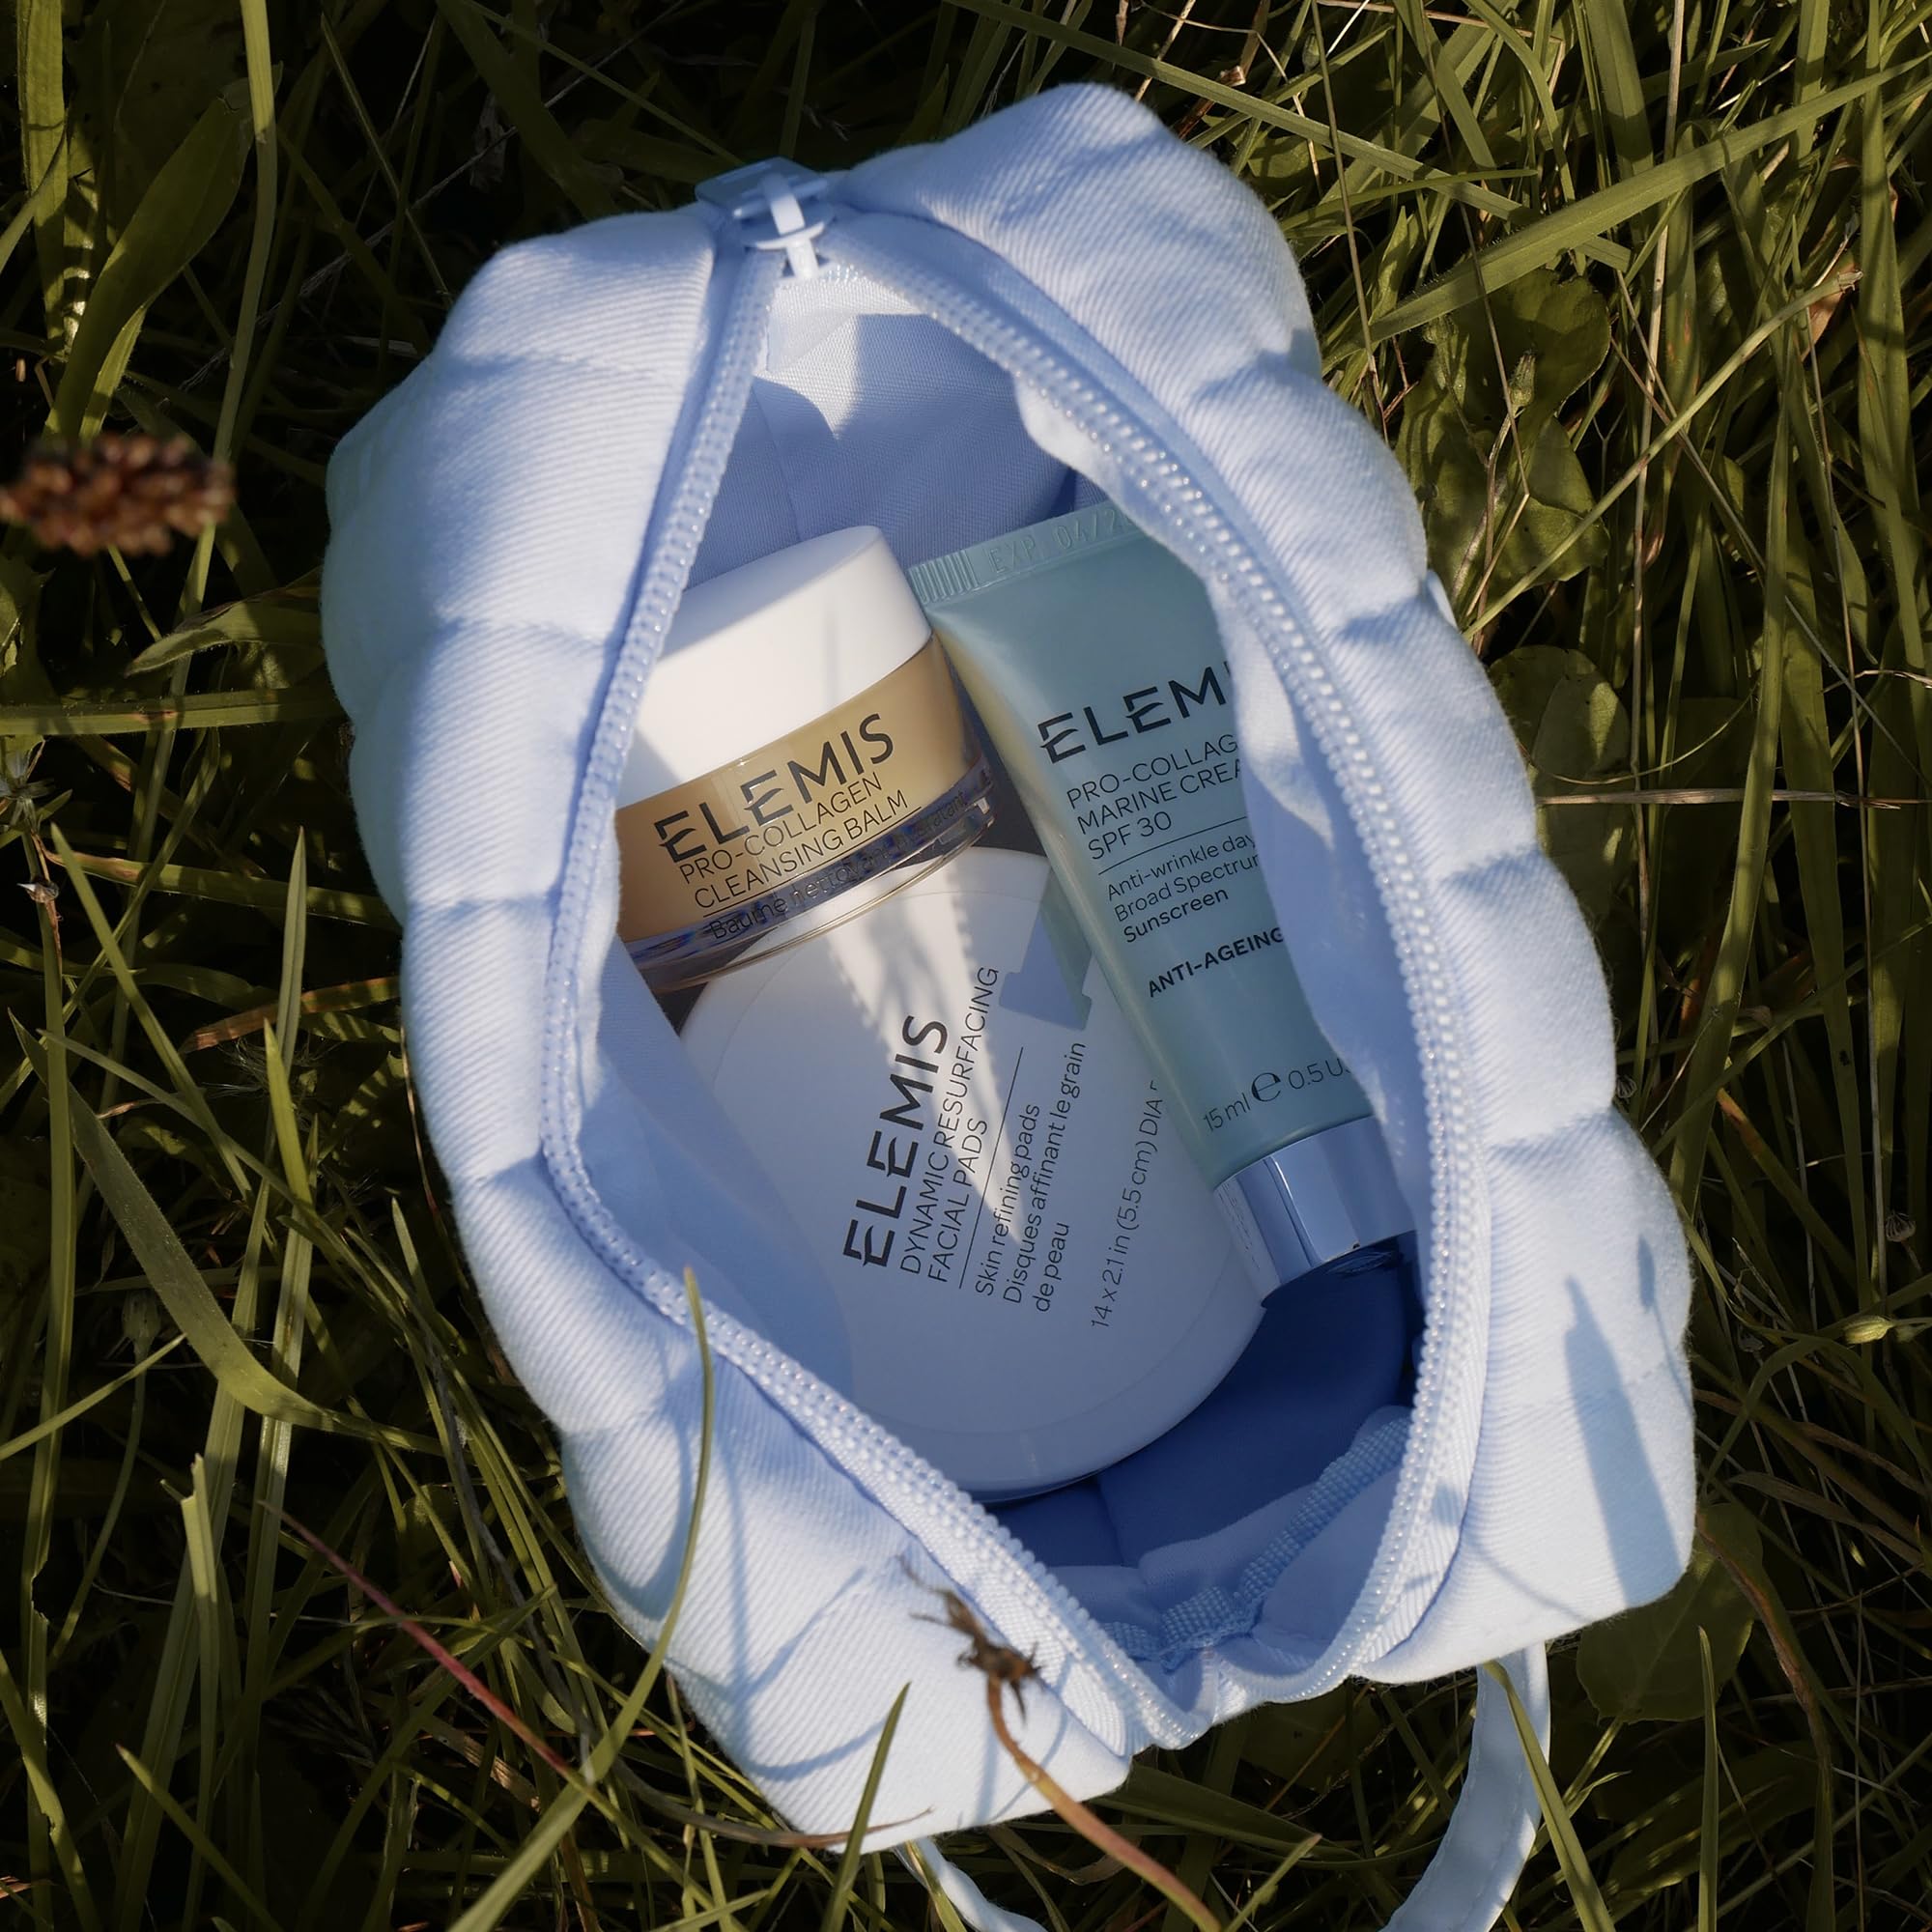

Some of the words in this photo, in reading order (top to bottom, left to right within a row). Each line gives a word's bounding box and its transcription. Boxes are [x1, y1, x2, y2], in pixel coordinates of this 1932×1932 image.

[654, 713, 894, 863] ELEMIS
[1077, 781, 1178, 835] MARINE
[679, 772, 882, 884] PRO-COLLAGEN
[695, 829, 843, 908] CLEANSING
[847, 789, 907, 840] BALM
[1089, 823, 1132, 860] SPF
[1140, 811, 1172, 838] 30
[1108, 840, 1219, 901] Anti-wrinkle
[1114, 883, 1172, 922] Broad
[1123, 888, 1229, 943] Sunscreen
[1148, 926, 1284, 998] ANTI-AGEING
[901, 1152, 950, 1275] DYNAMIC
[933, 967, 999, 1150] RESURFACING
[1139, 1080, 1163, 1136] DIA
[1203, 1108, 1224, 1132] 15
[1225, 1093, 1251, 1122] ml
[1288, 1063, 1323, 1090] 0.5
[843, 1015, 948, 1266] ELEMIS
[1131, 1138, 1157, 1186] cm)
[928, 1194, 969, 1282] FACIAL
[954, 1118, 987, 1182] PADS
[976, 1247, 1003, 1296] Skin
[990, 1163, 1030, 1244] refining
[1014, 1104, 1040, 1165] pads
[1004, 1214, 1041, 1303] Disques
[1030, 1122, 1066, 1210] affinant
[1050, 1100, 1070, 1121] le
[1062, 1041, 1086, 1097] grain
[1118, 1188, 1142, 1231] (5.5
[1043, 1222, 1069, 1281] peau
[1102, 1259, 1123, 1286] 2.1
[1108, 1236, 1129, 1255] in
[1033, 1282, 1054, 1312] de
[1092, 1305, 1111, 1327] 14
[1102, 1289, 1117, 1301] x
